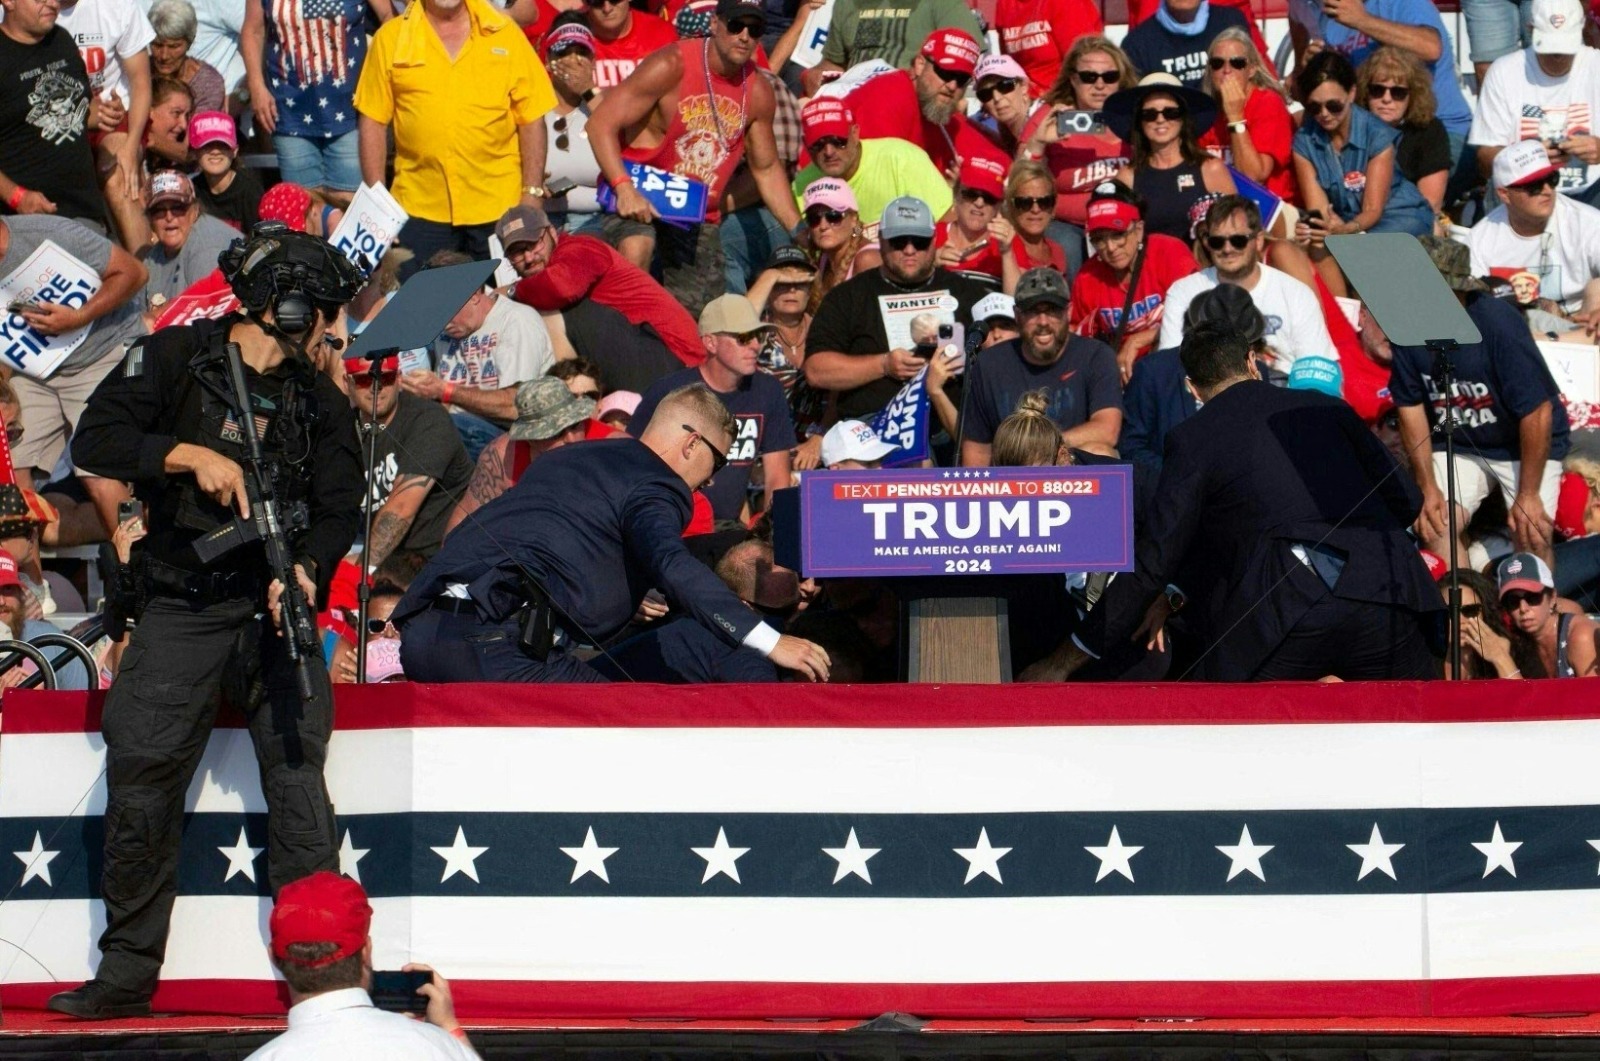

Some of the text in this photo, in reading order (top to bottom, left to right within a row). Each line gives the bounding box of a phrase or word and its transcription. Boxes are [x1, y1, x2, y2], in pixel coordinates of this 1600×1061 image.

[859, 8, 911, 18] LAND OF THE FREE
[592, 58, 645, 87] LTR
[806, 182, 842, 196] TRUMP
[35, 266, 55, 289] JOE
[0, 273, 73, 341] YO'RE
[886, 297, 940, 310] WANTE
[4, 278, 97, 370] FID!
[884, 383, 911, 440] 024
[841, 481, 1093, 498] TEXT PENNSYLVANIA TO 88022
[863, 500, 1072, 540] TRUMP
[874, 543, 1061, 556] MAKE AMERICA GREAT AGAIN!
[945, 559, 992, 573] 2024
